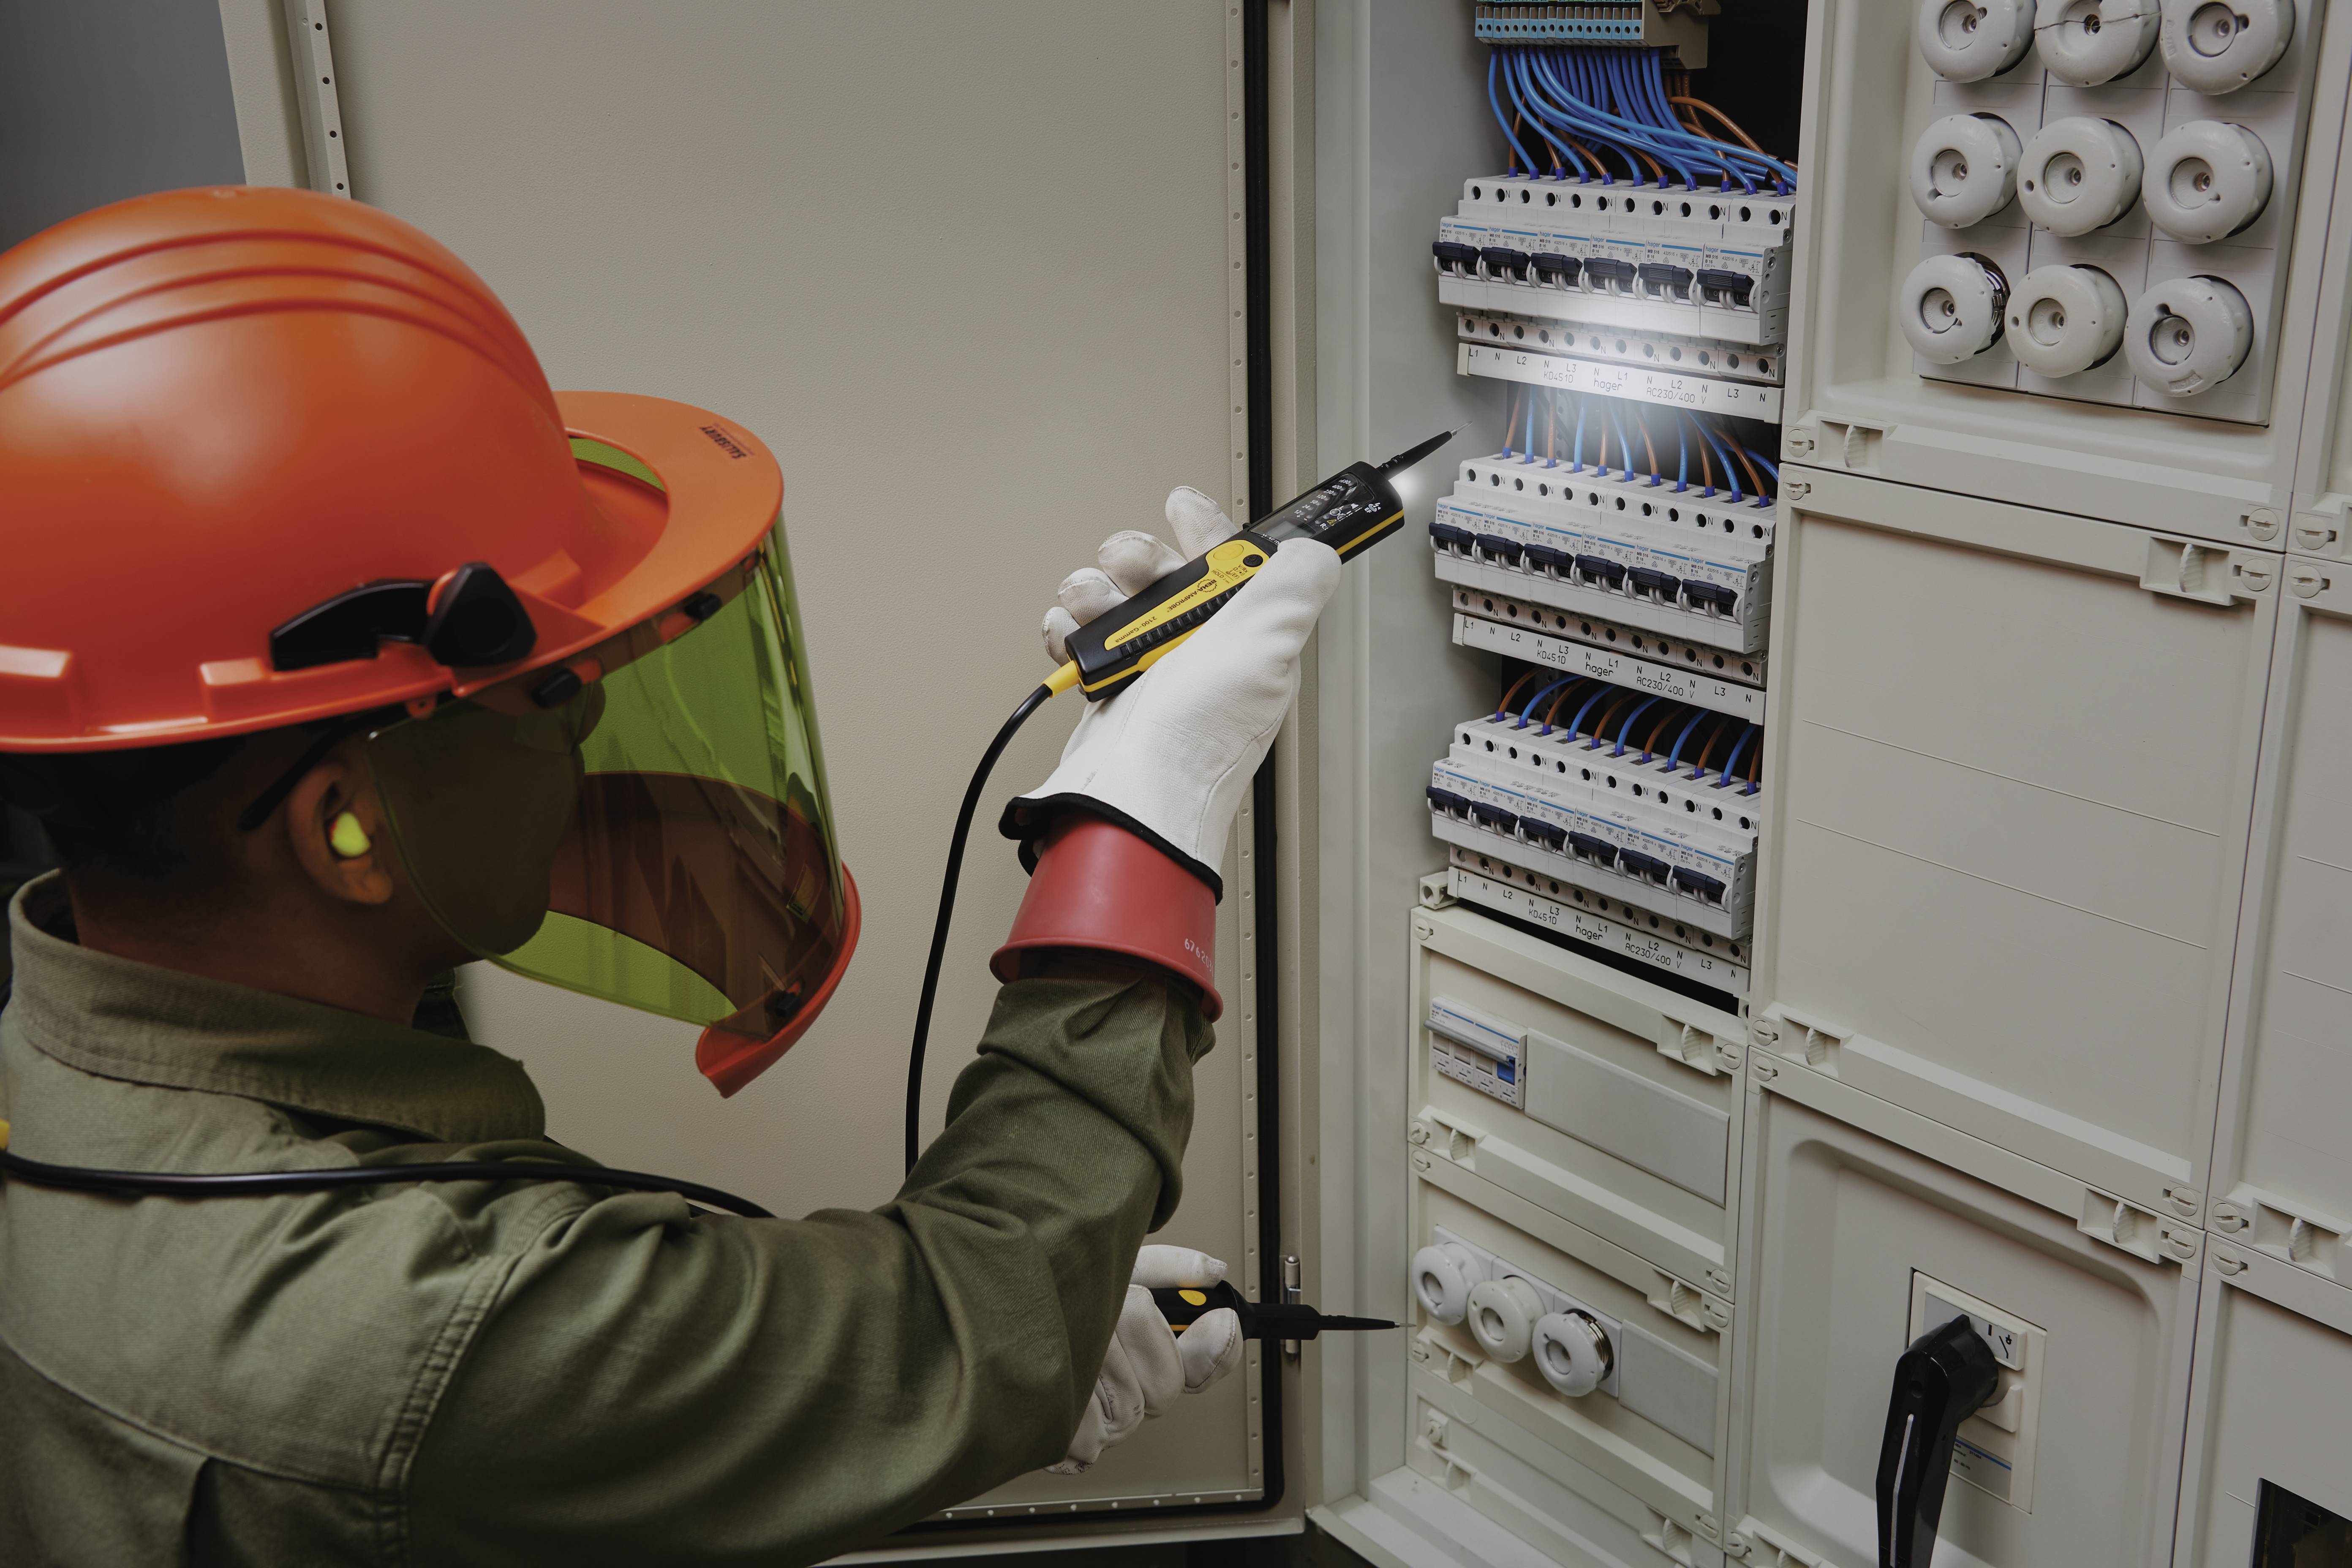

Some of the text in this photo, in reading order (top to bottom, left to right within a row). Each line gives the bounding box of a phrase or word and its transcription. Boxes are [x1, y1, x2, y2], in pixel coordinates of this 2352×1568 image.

[1505, 190, 1510, 198] N
[1556, 194, 1561, 202] N
[1608, 199, 1612, 207] N
[1663, 203, 1668, 211] N
[1720, 207, 1726, 216] N
[1781, 212, 1787, 220] N
[1647, 241, 1661, 249] hager
[1706, 246, 1719, 254] hager
[1549, 339, 1554, 347] N
[1601, 346, 1606, 354] N
[1654, 354, 1659, 362] N
[1710, 361, 1715, 369] N
[1469, 348, 1478, 357] L1
[1495, 352, 1500, 360] N
[1517, 356, 1527, 365] L2
[1566, 363, 1576, 372] L3
[1594, 368, 1599, 376] N
[1618, 371, 1628, 381] L1
[1647, 376, 1652, 384] N
[1671, 380, 1682, 389] L2
[1702, 384, 1707, 393] N
[1728, 389, 1739, 398] L3
[1760, 393, 1765, 402] N
[1769, 369, 1775, 377] N
[1544, 370, 1707, 404] KD451D hager AC230/400 V
[1549, 486, 1553, 494] N
[1600, 495, 1604, 504] N
[1653, 506, 1658, 514] N
[1708, 517, 1713, 525] N
[1764, 528, 1769, 536] N
[1691, 556, 1704, 564] hager
[1211, 570, 1224, 578] HOLD
[1494, 609, 1498, 617] N
[1592, 632, 1596, 640] N
[1643, 645, 1648, 653] N
[1465, 620, 1473, 629] L1
[1511, 632, 1520, 642] L2
[1538, 640, 1542, 648] N
[1559, 645, 1568, 654] L3
[1586, 652, 1591, 660] N
[1609, 658, 1618, 667] L1
[1637, 666, 1642, 674] N
[1661, 672, 1671, 682] L2
[1690, 680, 1695, 688] N
[1715, 686, 1726, 696] L3
[1746, 694, 1751, 703] N
[1697, 659, 1702, 667] N
[1537, 650, 1695, 699] KD451D hager AC230/400 V
[1753, 672, 1759, 681] N
[1592, 772, 1596, 780] N
[1643, 787, 1648, 795] N
[1527, 795, 1538, 803] hager
[1696, 803, 1701, 812] N
[1751, 821, 1756, 830] N
[1681, 843, 1693, 852] hager
[1489, 867, 1494, 875] N
[1584, 900, 1589, 908] N
[1633, 917, 1639, 926] N
[1458, 875, 1467, 884] L1
[1483, 882, 1487, 890] N
[1503, 890, 1512, 899] L2
[1550, 906, 1559, 915] L3
[1576, 915, 1581, 923] N
[1598, 923, 1607, 933] L1
[1625, 933, 1631, 941] N
[1648, 941, 1659, 951] L2
[1677, 951, 1682, 959] N
[1701, 959, 1712, 969] L3
[1731, 970, 1735, 978] N
[1529, 908, 1681, 969] KD451D hager AC230/400 V
[1686, 936, 1690, 944] N
[1741, 955, 1746, 963] N
